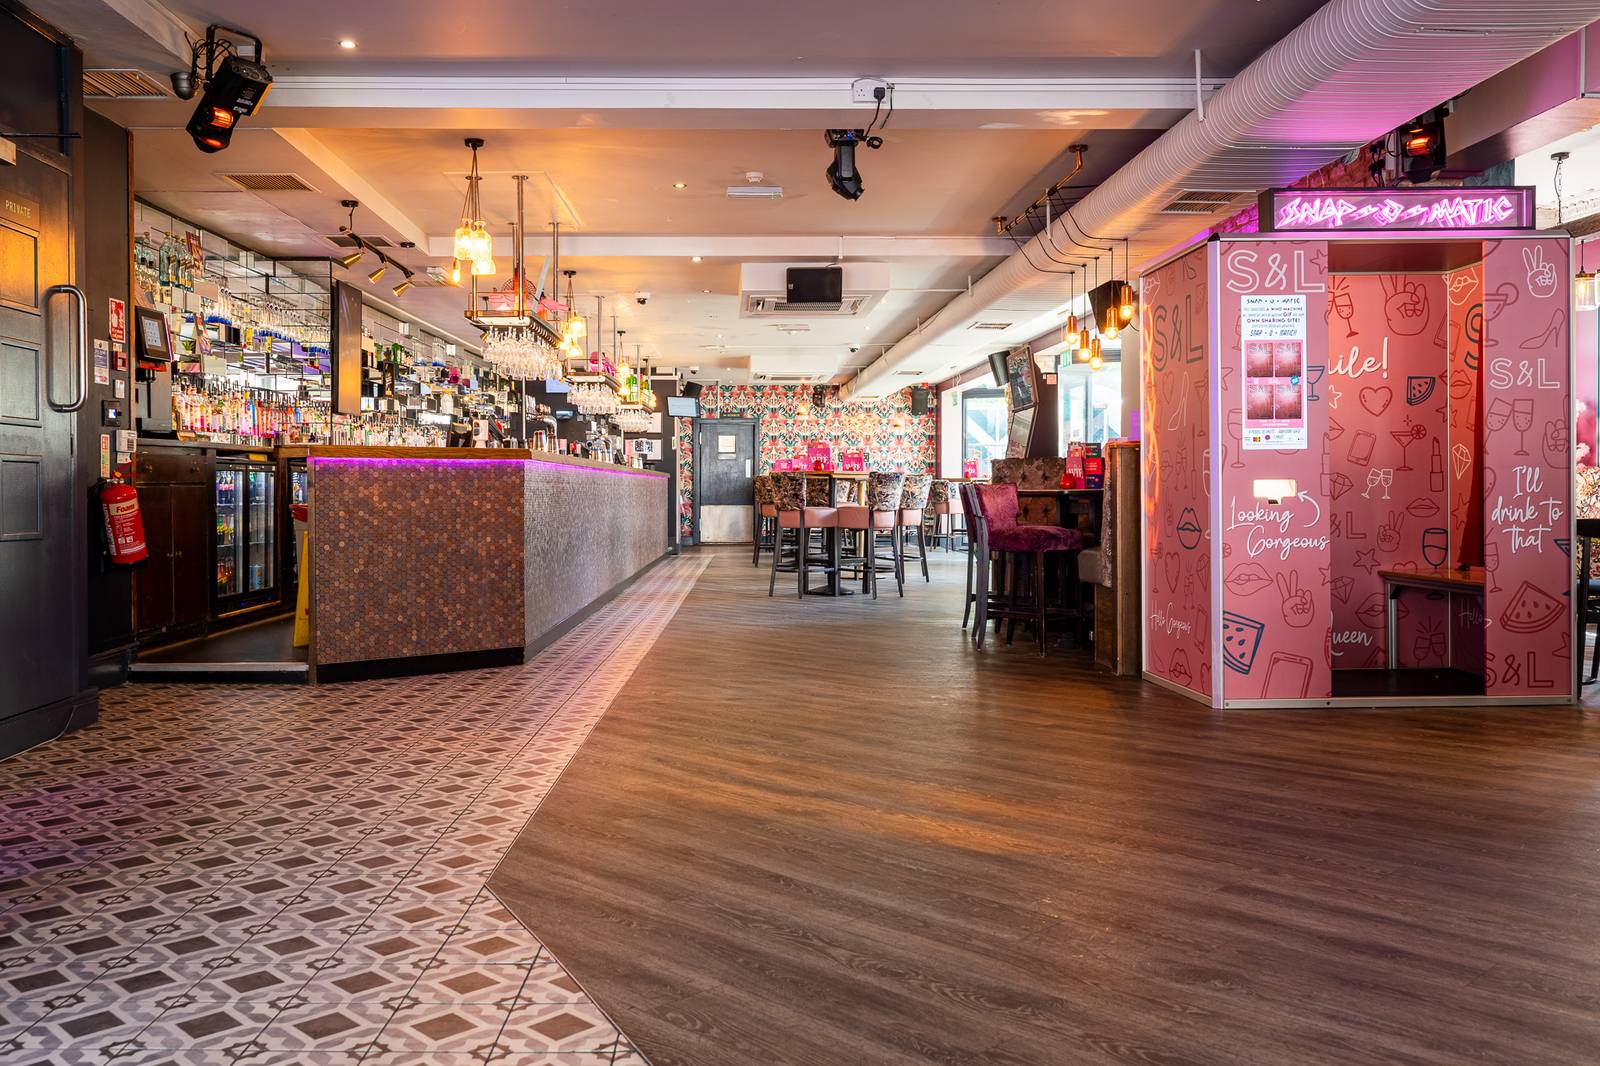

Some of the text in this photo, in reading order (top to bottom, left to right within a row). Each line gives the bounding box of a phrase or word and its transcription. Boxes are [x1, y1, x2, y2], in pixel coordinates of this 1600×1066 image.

[5, 199, 32, 219] PRIVATE
[1226, 249, 1325, 293] S&L
[1152, 294, 1204, 372] S&L
[1328, 336, 1389, 379] ile!
[1489, 357, 1561, 389] S&L
[1512, 465, 1543, 499] I'll
[116, 503, 135, 514] Foam
[1226, 495, 1294, 533] Looking
[1491, 495, 1538, 526] drink
[1247, 525, 1330, 560] Gorgeous
[1502, 524, 1552, 553] that
[1330, 610, 1373, 656] ueen
